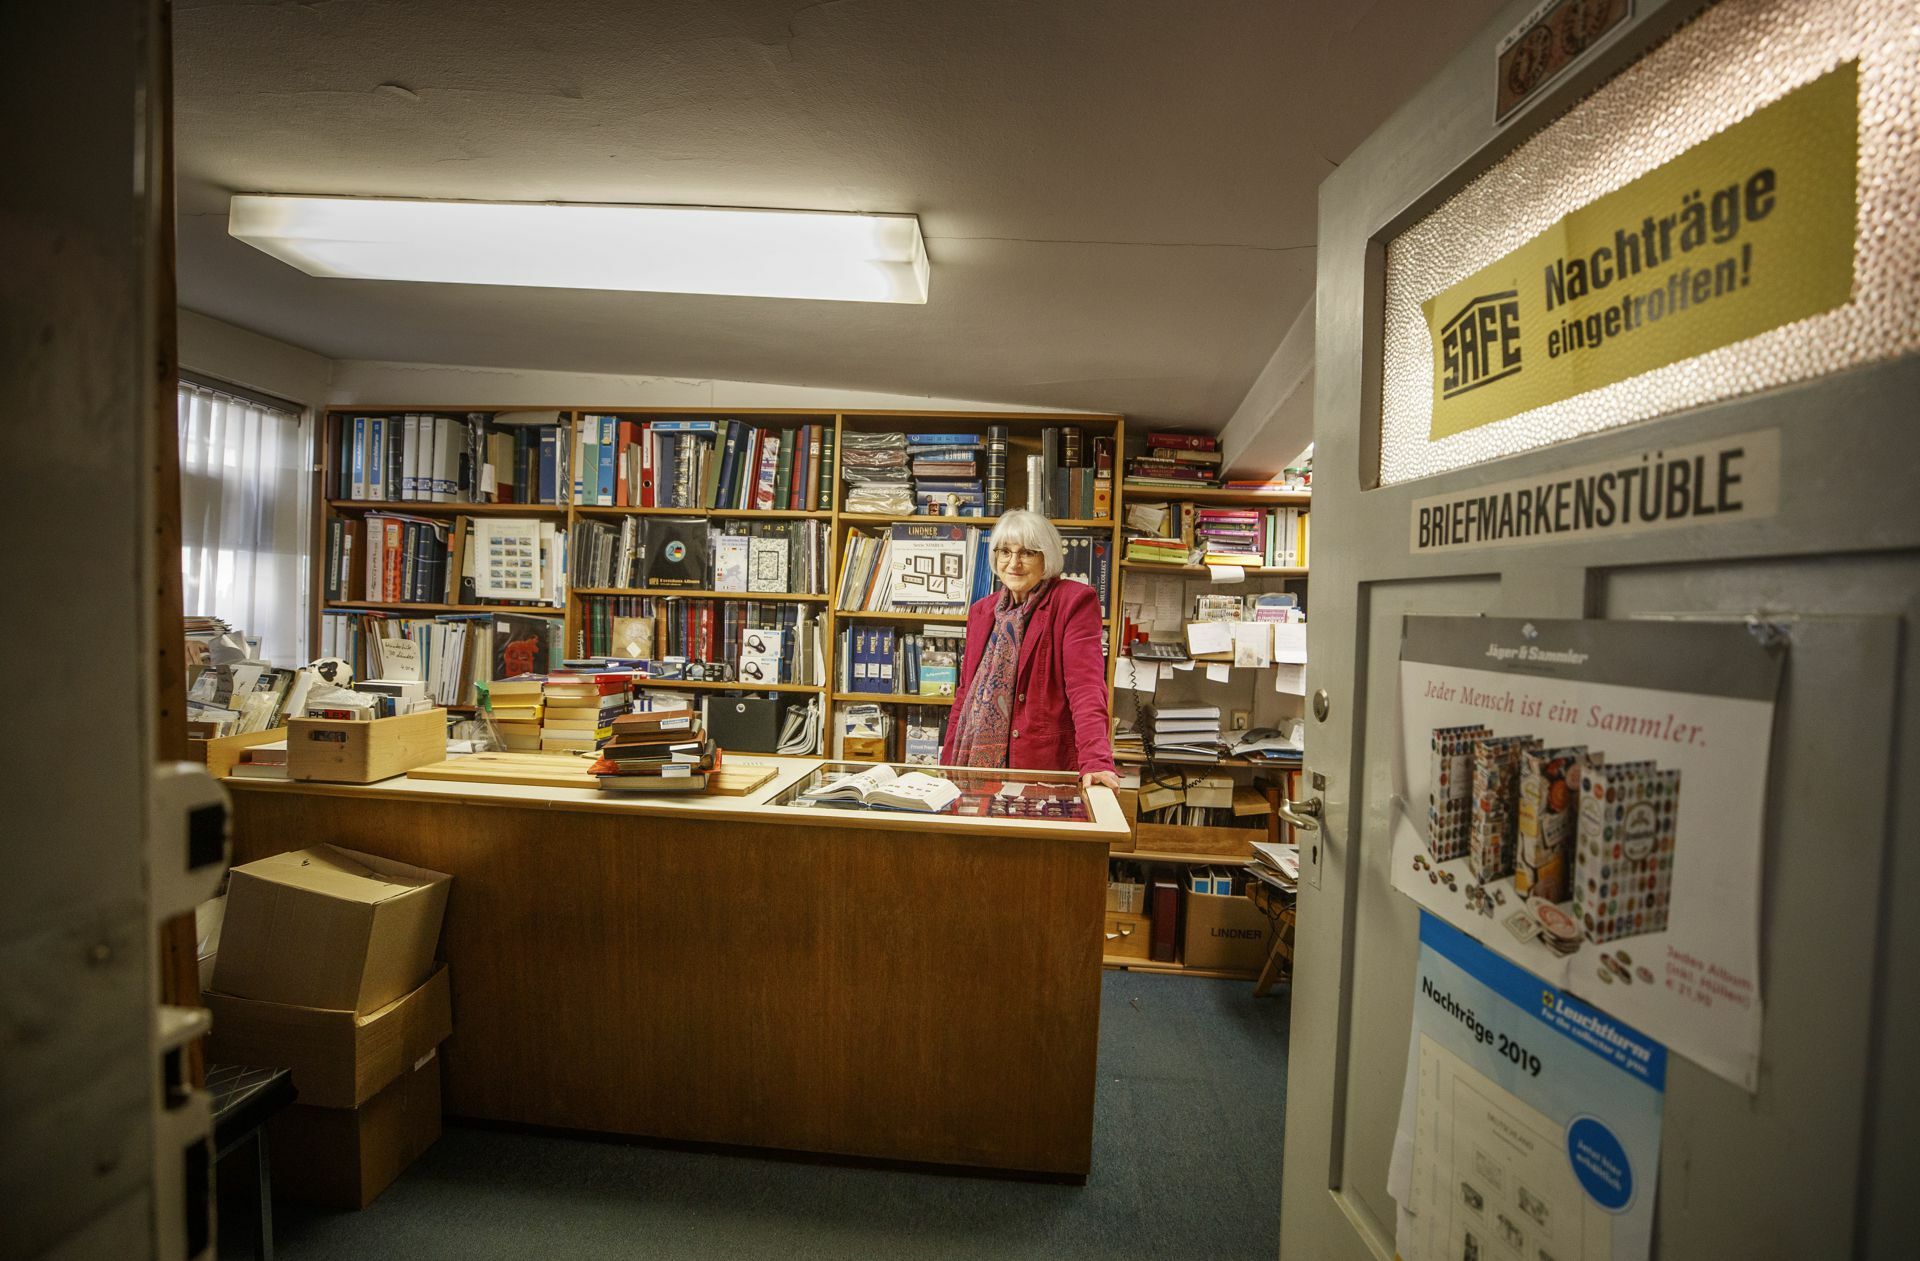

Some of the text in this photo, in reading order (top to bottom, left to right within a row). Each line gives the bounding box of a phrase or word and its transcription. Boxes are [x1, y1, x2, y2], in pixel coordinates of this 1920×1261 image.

[1545, 167, 1776, 312] Nachträge
[1548, 243, 1753, 360] eingetroffen!
[1443, 301, 1522, 394] SAFE
[908, 526, 938, 536] LINDNER
[1419, 447, 1744, 548] BRIEFMARKENSTÜBLE
[1528, 647, 1589, 665] Sammler
[308, 710, 350, 720] PHILEX
[1424, 680, 1708, 747] Jeder Mensch ist ein Sammler.
[1211, 927, 1263, 940] LINDNER
[1422, 976, 1542, 1077] Nachträge 2019
[1555, 998, 1651, 1062] Leuchtturm
